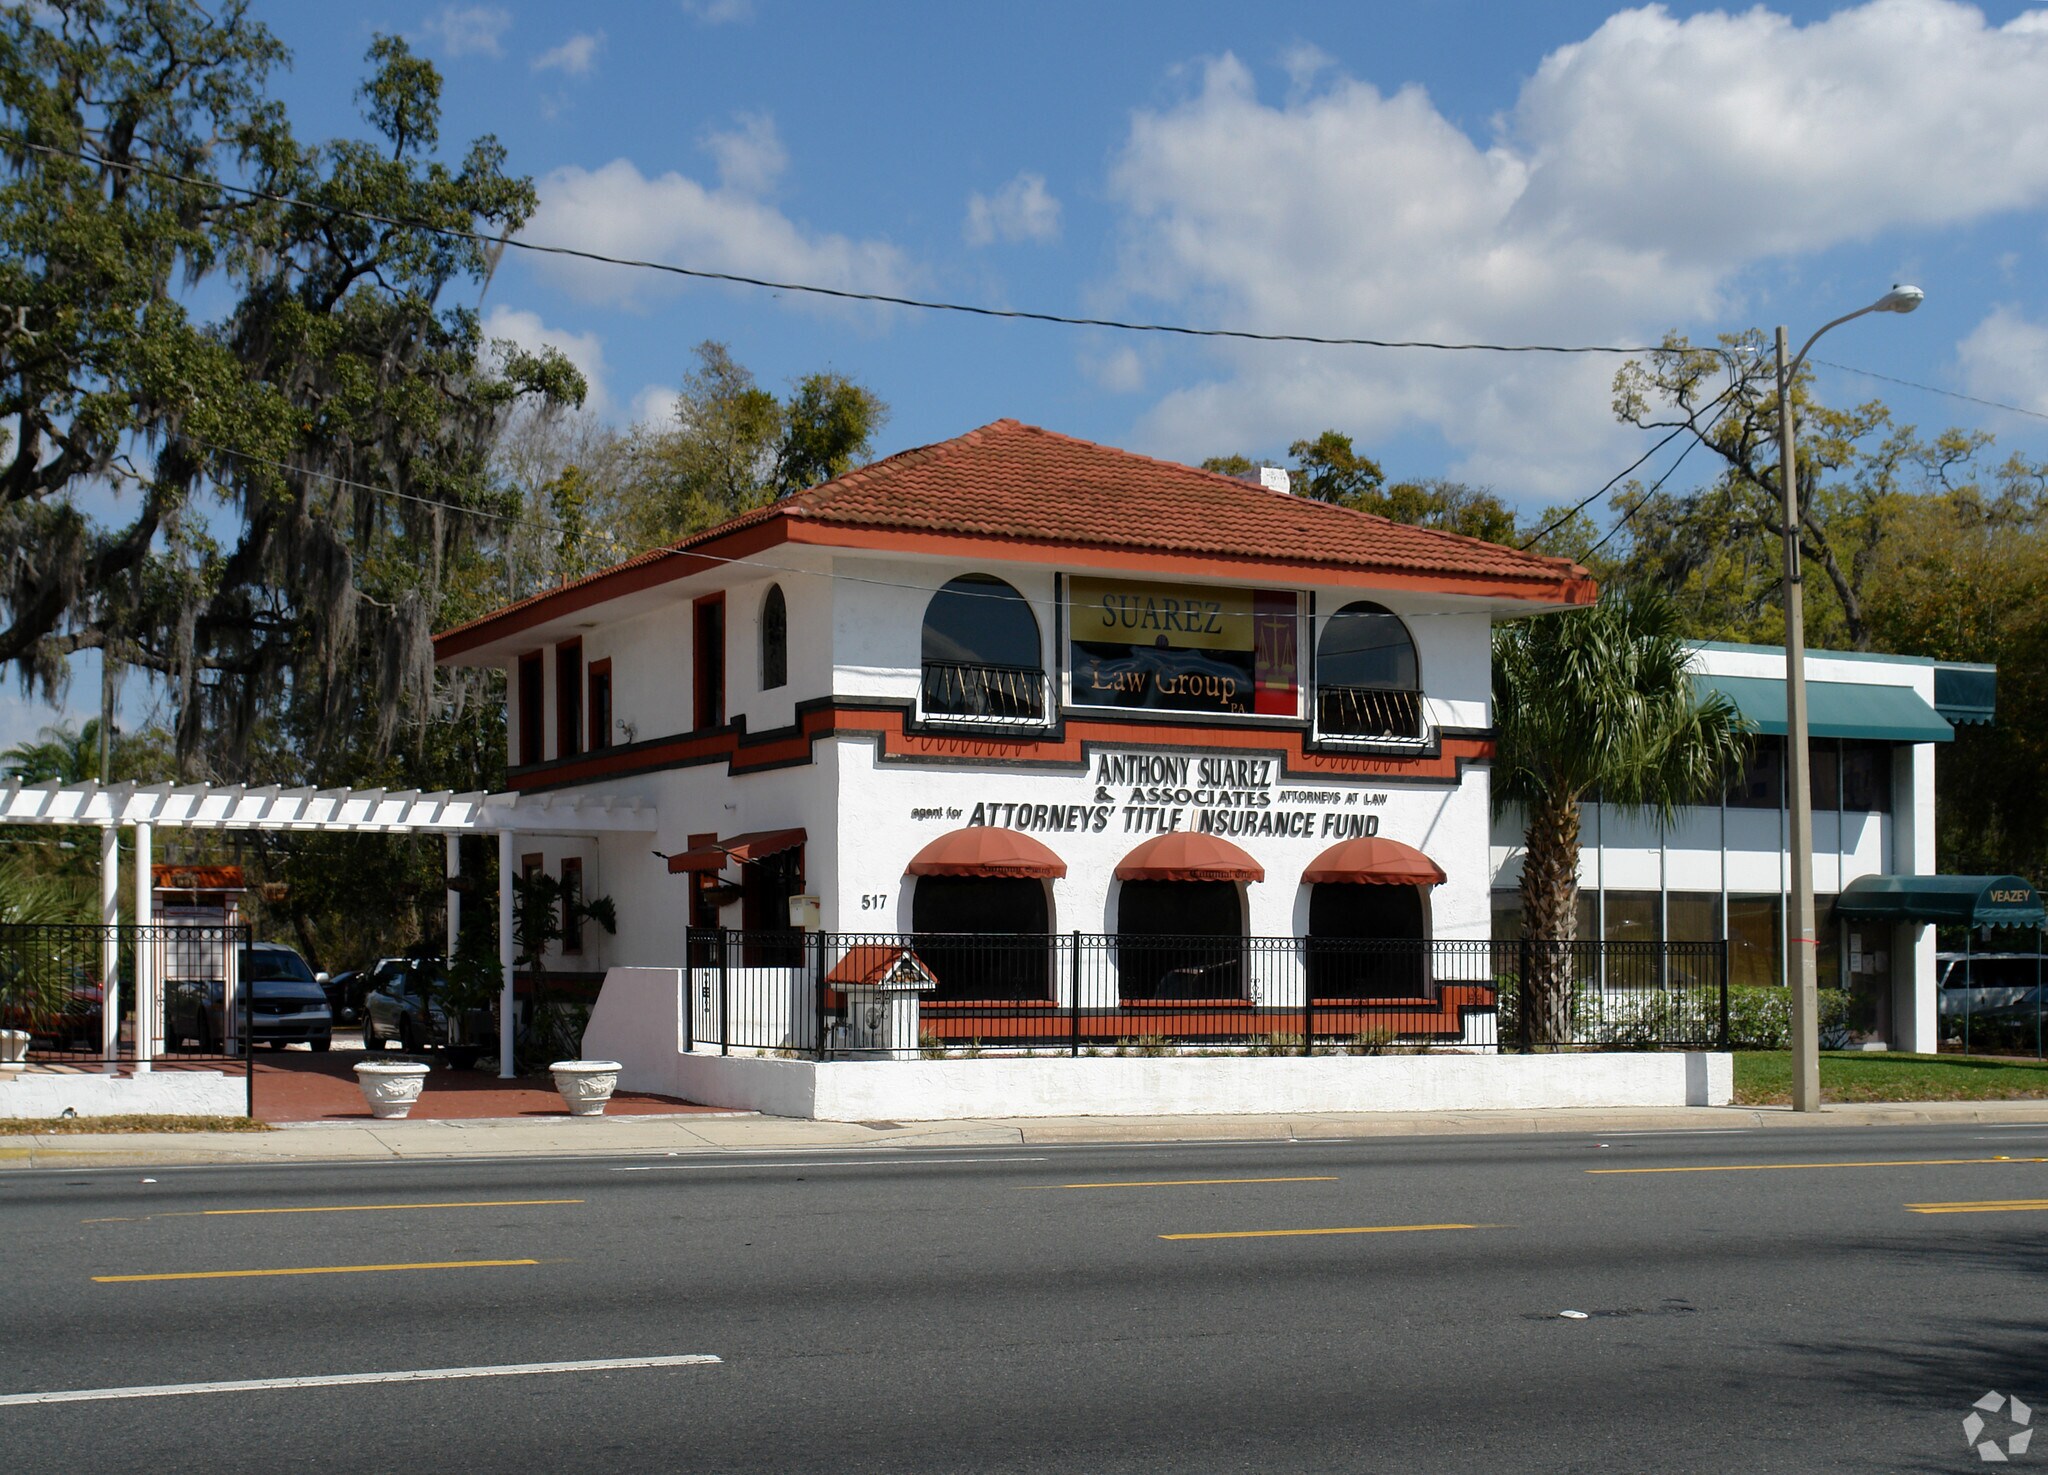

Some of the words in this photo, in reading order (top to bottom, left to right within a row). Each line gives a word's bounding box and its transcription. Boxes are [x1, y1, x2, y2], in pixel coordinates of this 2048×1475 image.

[1102, 593, 1222, 634] SUAREZ
[1091, 659, 1145, 693] Law
[1155, 663, 1236, 704] Group
[1096, 753, 1190, 787] ANTHONY
[1198, 757, 1272, 790] SUAREZ
[1094, 786, 1115, 803] &
[1129, 787, 1271, 808] ASSOCIATES
[1278, 790, 1341, 804] ATTORNEYS
[1345, 792, 1360, 804] AT
[1364, 793, 1388, 806] LAW
[911, 806, 943, 820] agent
[946, 807, 963, 819] for
[966, 802, 1116, 832] ATTORNEYS'
[1123, 806, 1182, 834] TITLE
[1190, 809, 1316, 837] INSURANCE
[1321, 813, 1379, 839] FUND
[861, 894, 887, 910] 517
[1990, 889, 2030, 902] VEAZEY
